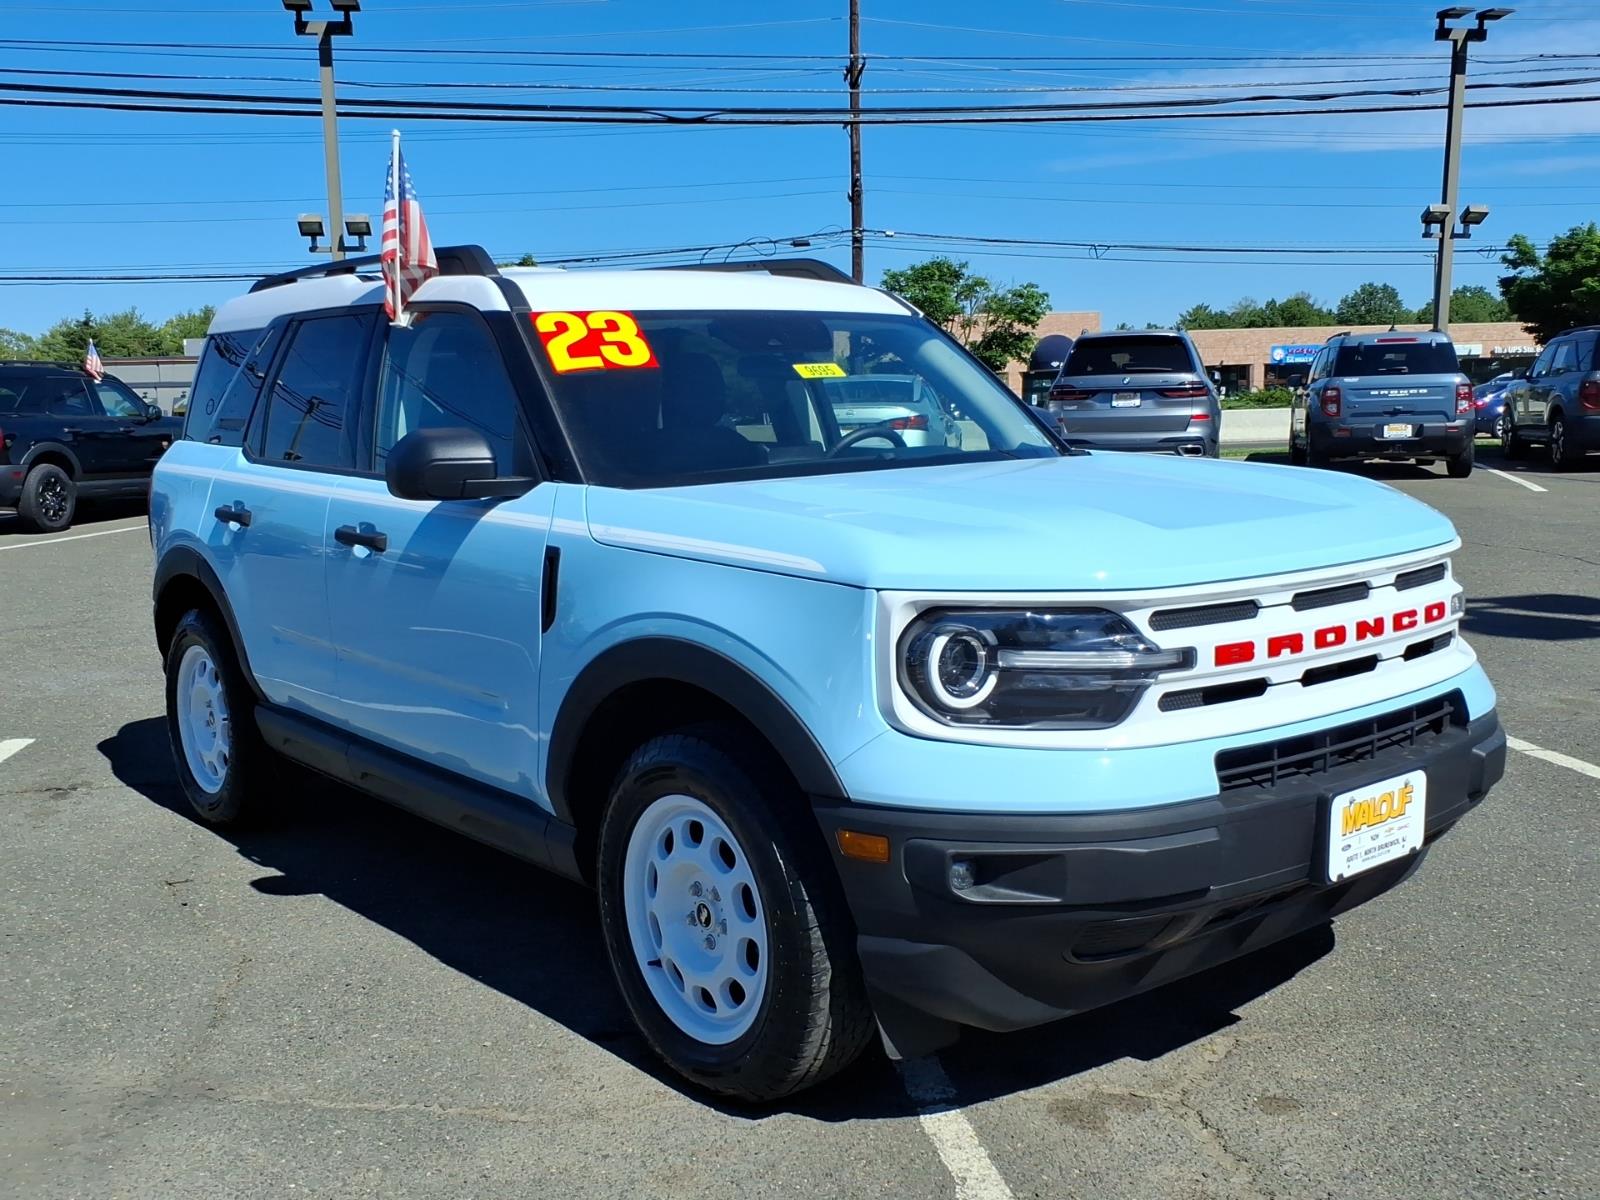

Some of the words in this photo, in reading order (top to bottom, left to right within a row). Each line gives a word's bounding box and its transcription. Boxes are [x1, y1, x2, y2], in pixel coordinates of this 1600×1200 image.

[535, 311, 652, 372] 23
[804, 365, 836, 376] 9695
[1214, 601, 1446, 667] BRONCO
[1341, 785, 1413, 837] MALOUF
